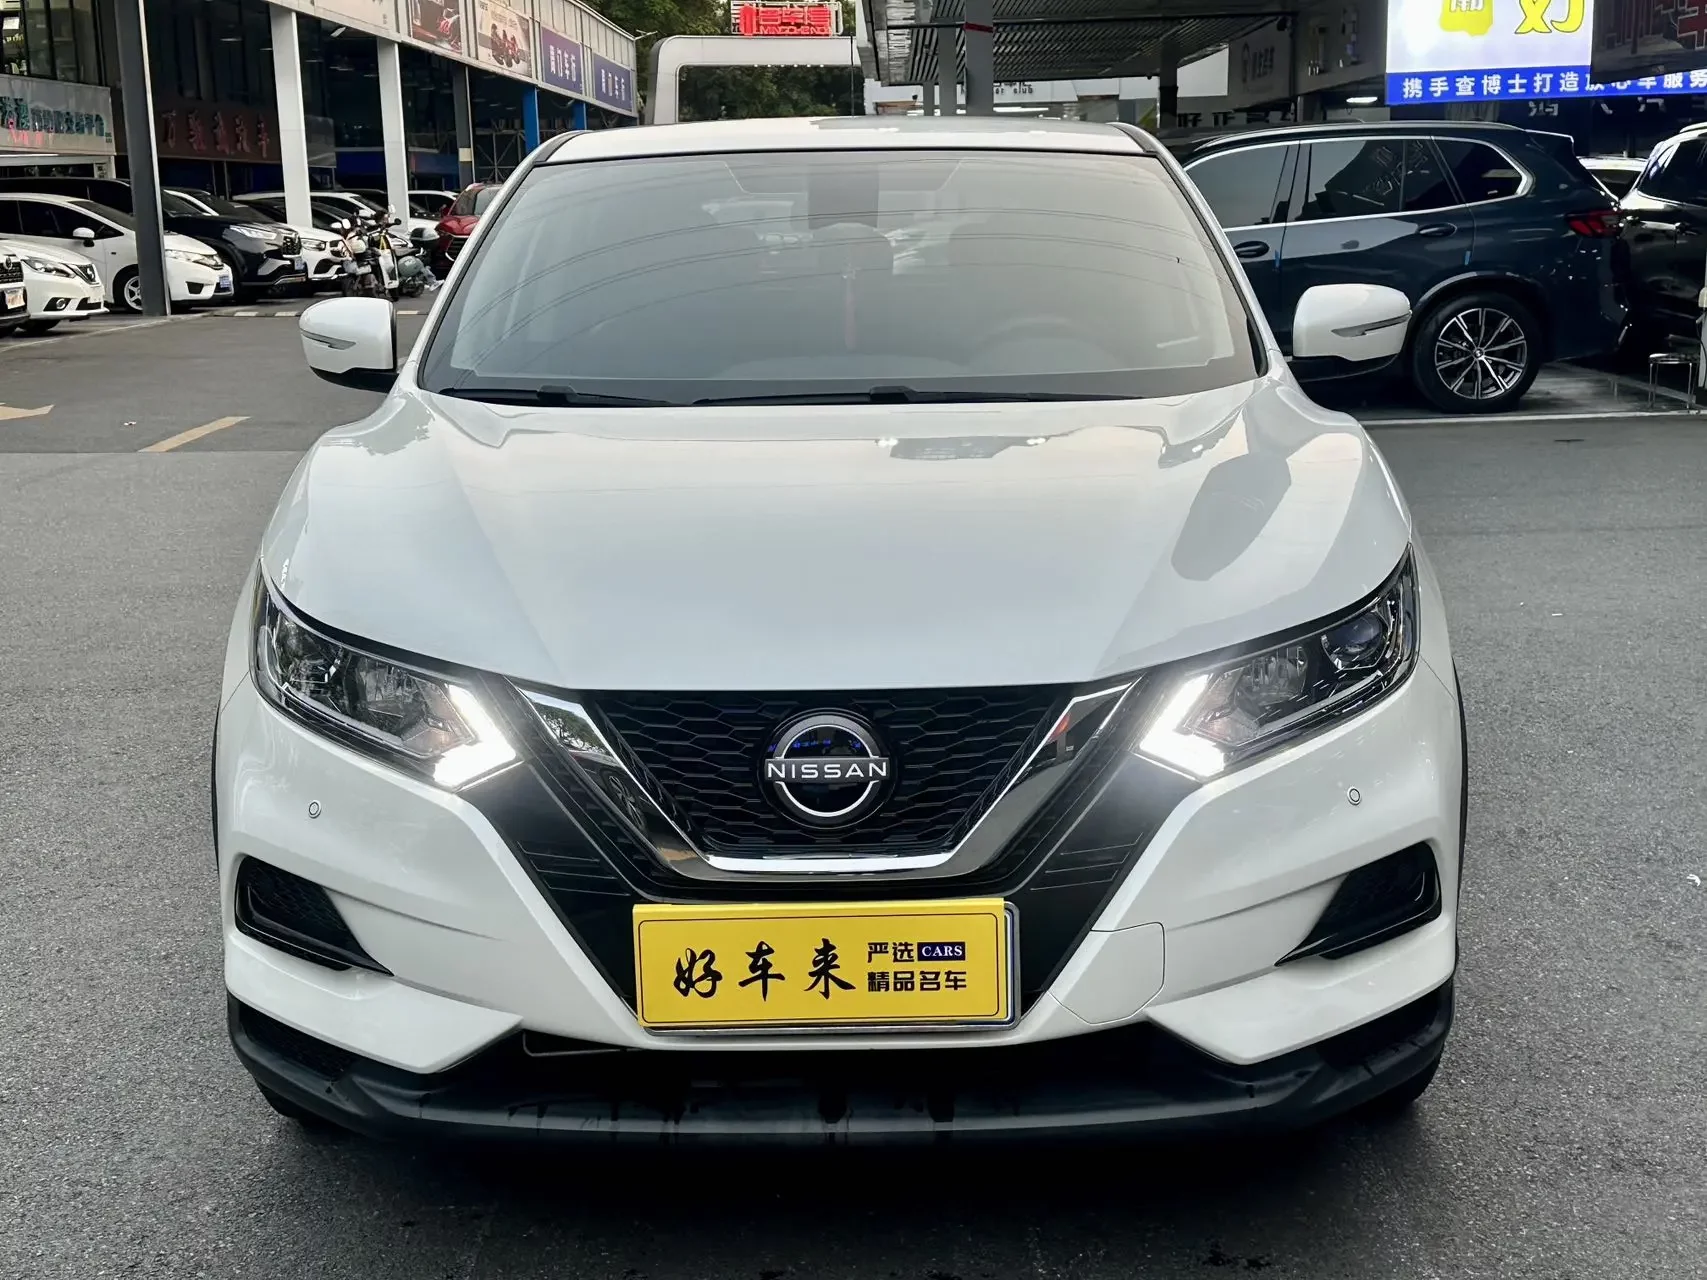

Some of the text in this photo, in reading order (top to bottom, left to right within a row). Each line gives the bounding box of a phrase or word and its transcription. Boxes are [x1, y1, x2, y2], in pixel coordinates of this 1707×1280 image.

[767, 761, 888, 779] NISSAN
[868, 942, 963, 963] 严选 CARS
[673, 938, 855, 1002] 好车来
[867, 970, 967, 992] 精品名车
